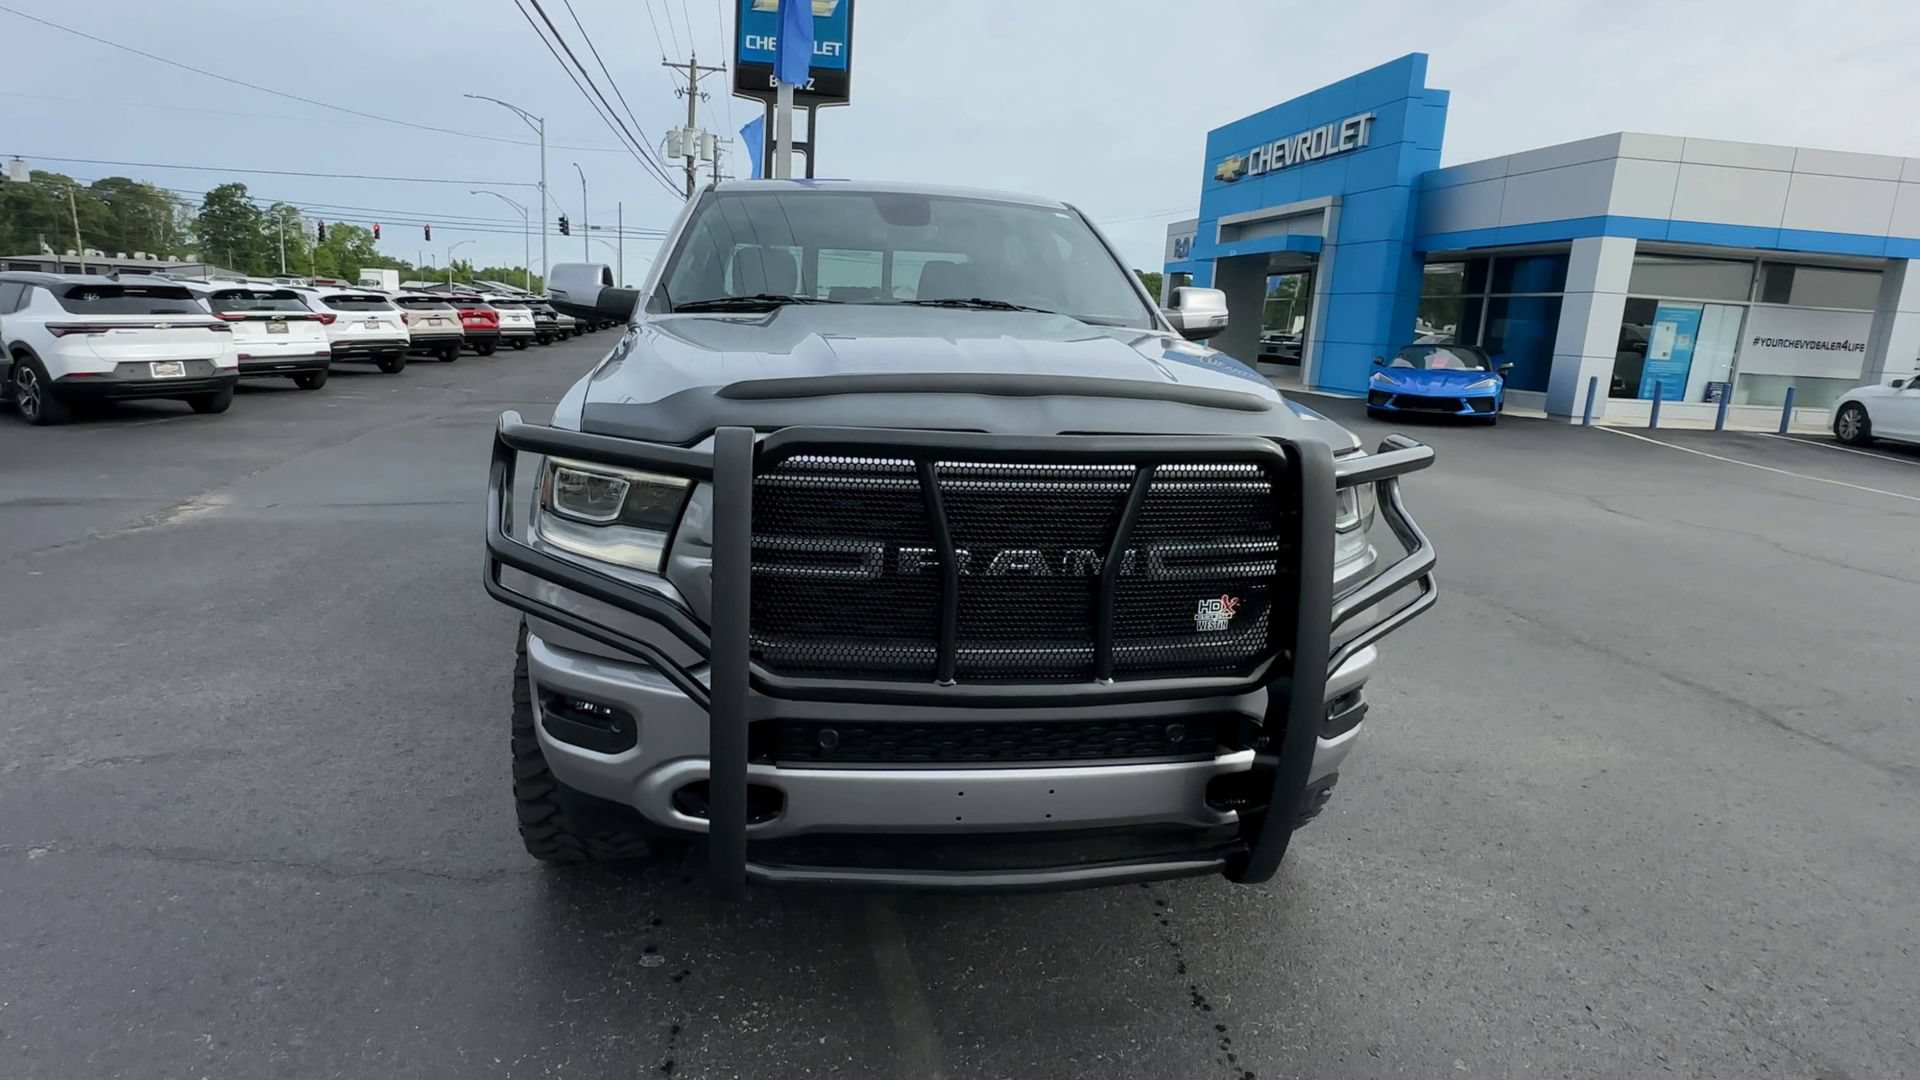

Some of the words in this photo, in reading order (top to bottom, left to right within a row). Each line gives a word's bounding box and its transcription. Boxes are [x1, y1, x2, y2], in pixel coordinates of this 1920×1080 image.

[745, 34, 843, 57] CHELET
[1248, 112, 1376, 176] CHEVROLET
[1752, 336, 1866, 353] #YOURCHEVYDEALER4LIFE
[899, 547, 1137, 577] RAM
[1198, 594, 1240, 615] HDX
